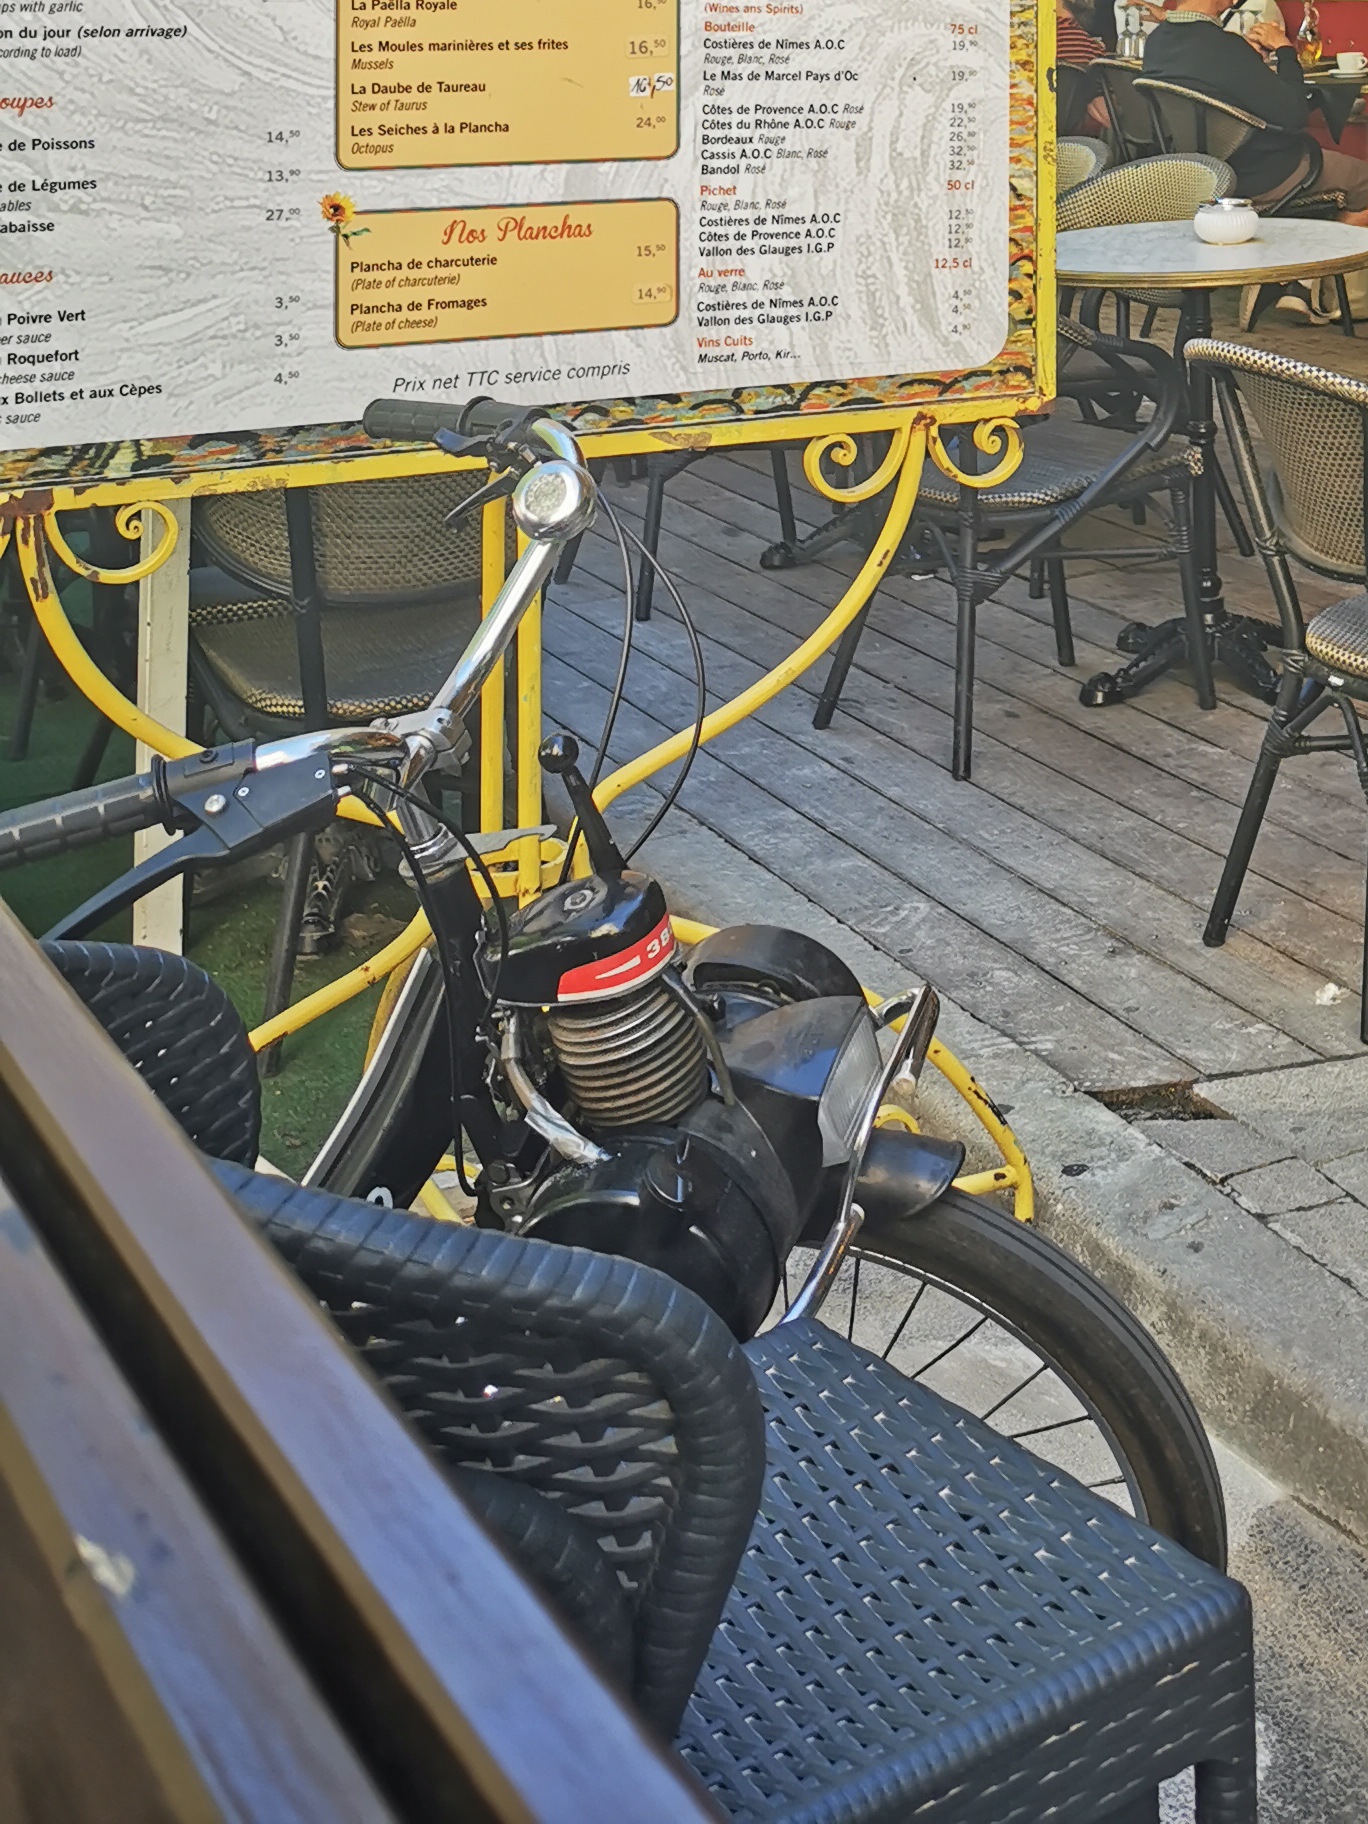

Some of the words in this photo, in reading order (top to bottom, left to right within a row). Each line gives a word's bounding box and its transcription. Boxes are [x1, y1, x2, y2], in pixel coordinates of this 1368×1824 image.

[350, 40, 374, 53] Les
[378, 40, 424, 53] Moules
[428, 39, 494, 52] marinières
[497, 39, 511, 51] et
[513, 41, 534, 51] ses
[537, 38, 569, 51] frites
[350, 82, 367, 95] La
[371, 81, 413, 95] Daube
[416, 81, 433, 94] de
[436, 80, 486, 93] Taureau
[350, 124, 374, 137] Les
[377, 123, 428, 137] Seiches
[431, 122, 440, 135] à
[444, 122, 456, 135] la
[459, 121, 510, 134] Plancha
[7, 138, 27, 152] de
[31, 137, 96, 151] Poissons
[699, 184, 737, 197] Pichet
[441, 219, 488, 246] Nos
[496, 213, 593, 242] Planchas
[350, 259, 403, 274] Plancha
[406, 257, 423, 270] de
[426, 253, 498, 270] charcuterie
[350, 301, 403, 316] Plancha
[406, 300, 423, 312] de
[427, 297, 488, 311] Fromages
[392, 377, 426, 393] Prix
[432, 374, 460, 390] net
[467, 369, 500, 387] TTC
[504, 368, 562, 385] service
[566, 363, 631, 380] compris
